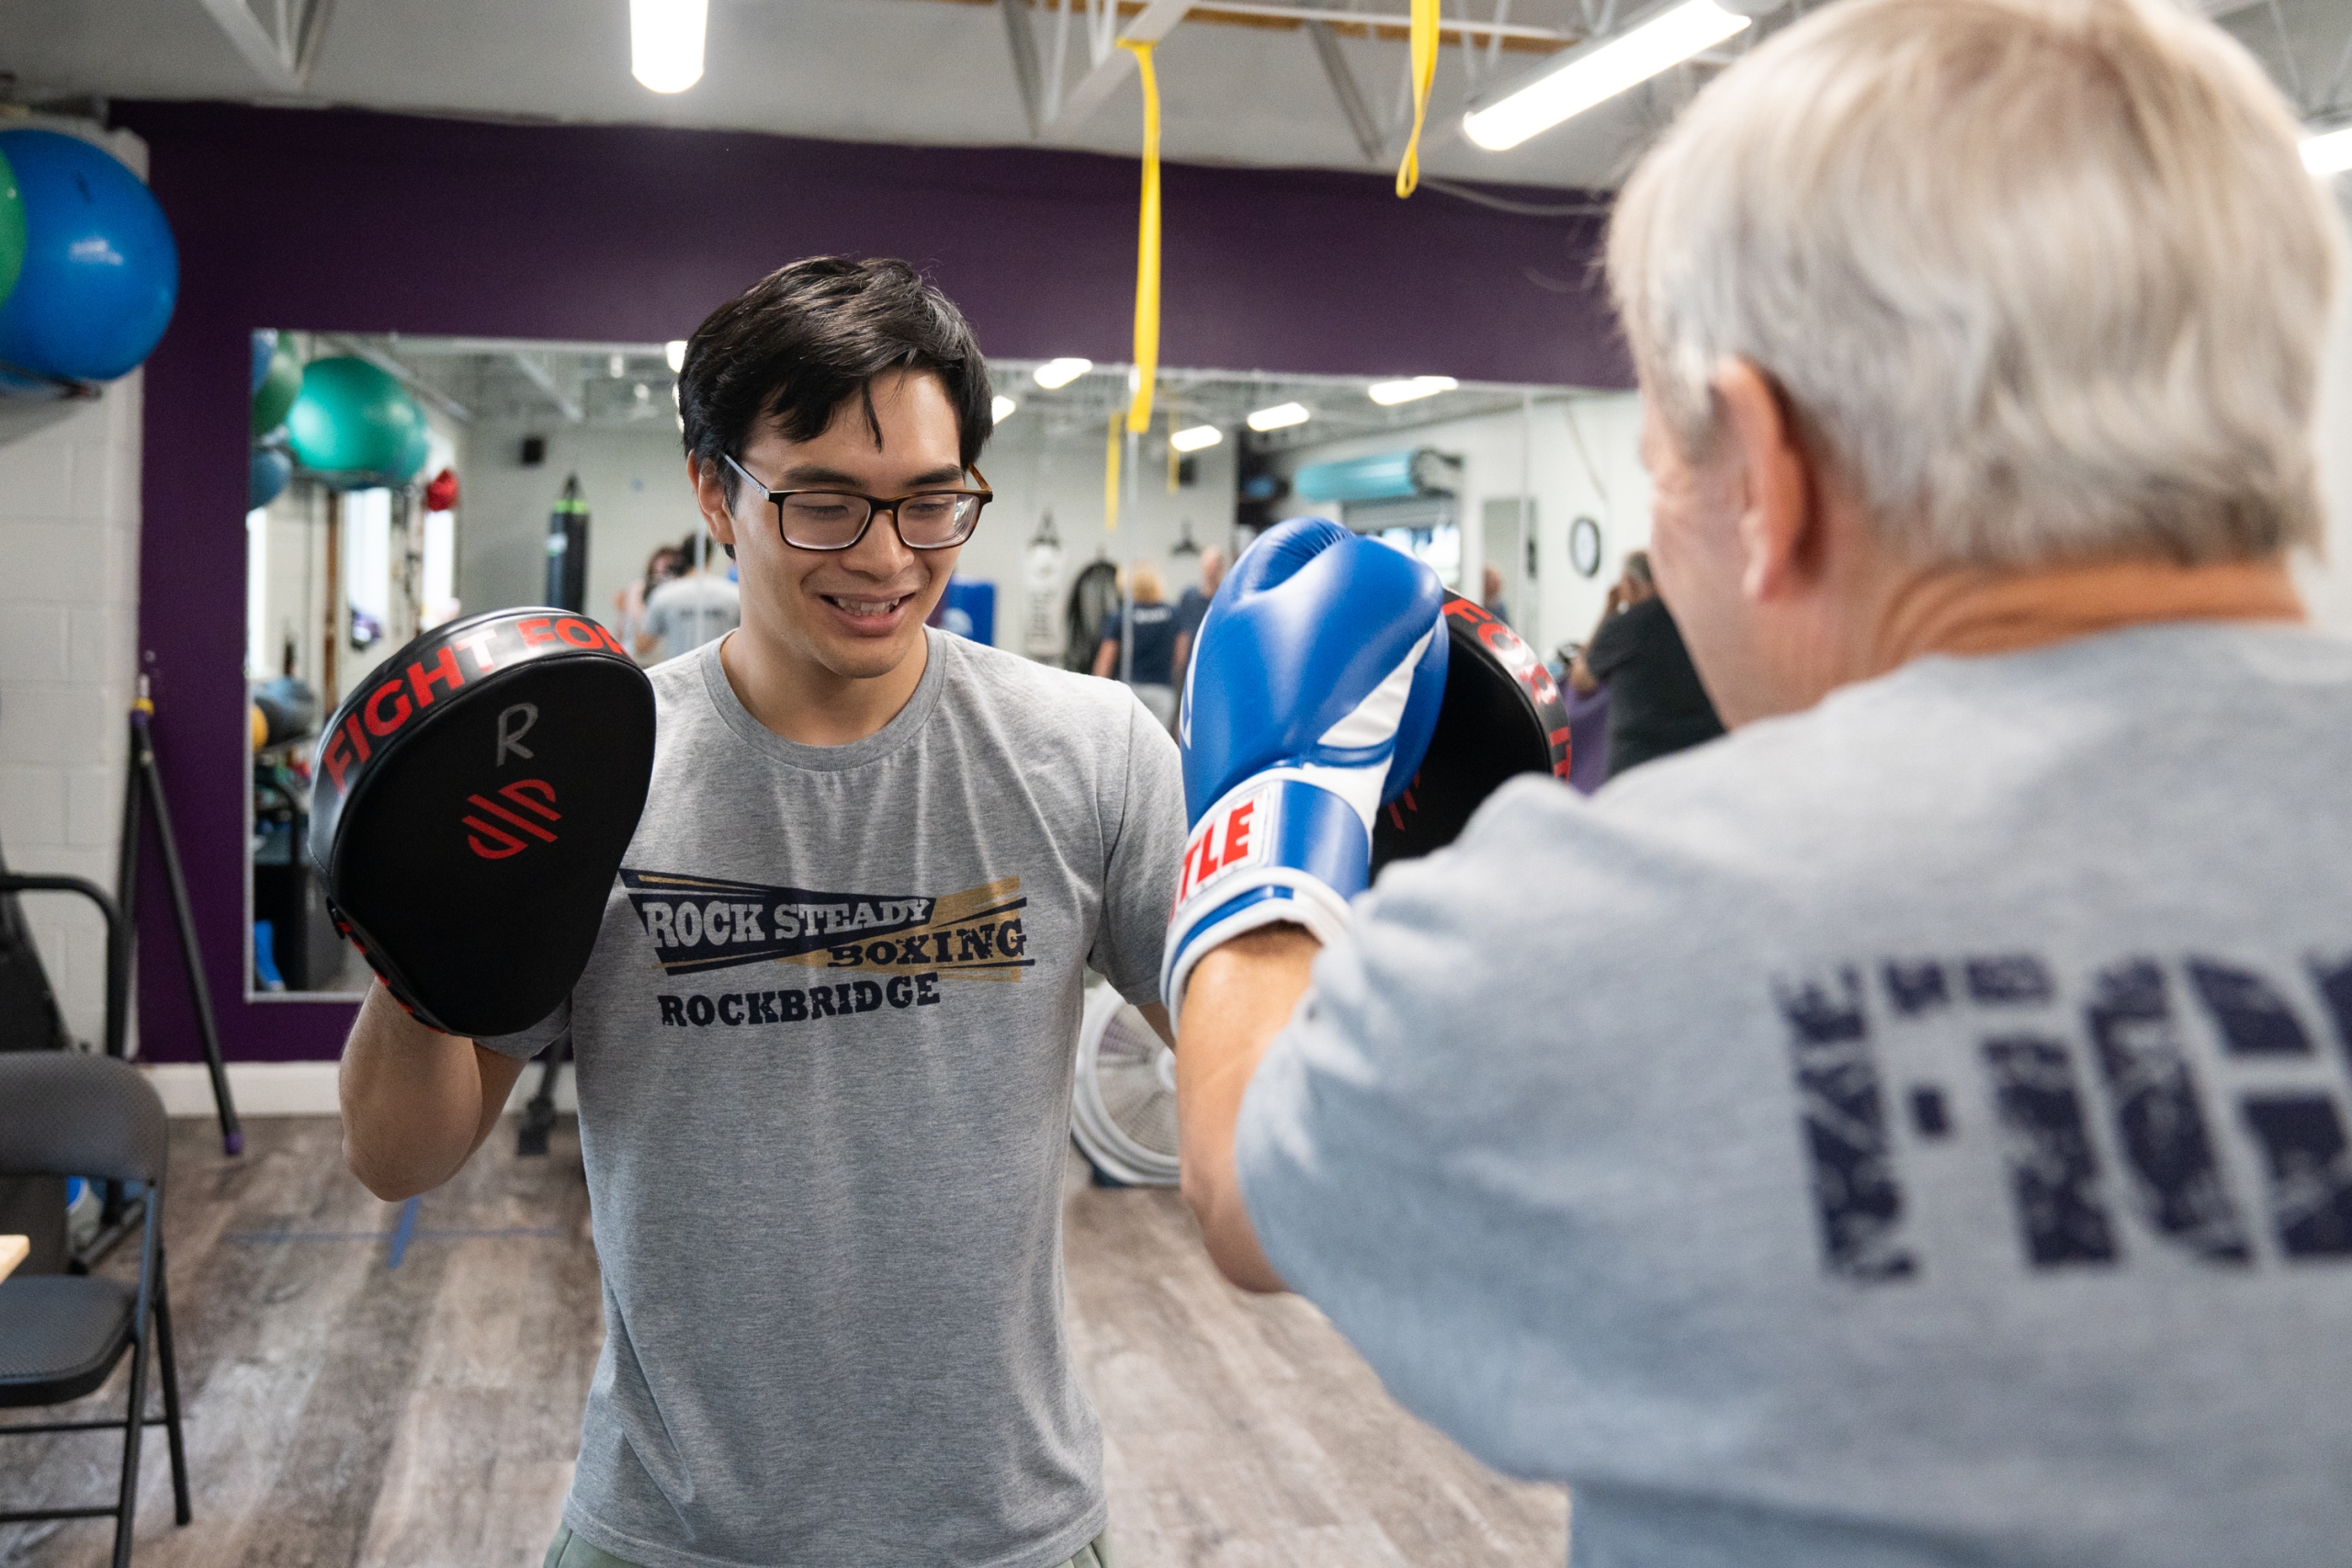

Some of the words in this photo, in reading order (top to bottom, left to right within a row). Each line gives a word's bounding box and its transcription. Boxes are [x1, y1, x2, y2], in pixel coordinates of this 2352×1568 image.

[322, 630, 499, 796] FIGHT
[496, 702, 539, 768] R
[1168, 797, 1255, 926] TLE
[642, 900, 765, 948] ROCK
[773, 898, 930, 941] STEADY
[828, 919, 1027, 968] BOXING
[657, 972, 941, 1028] ROCKBRIDGE
